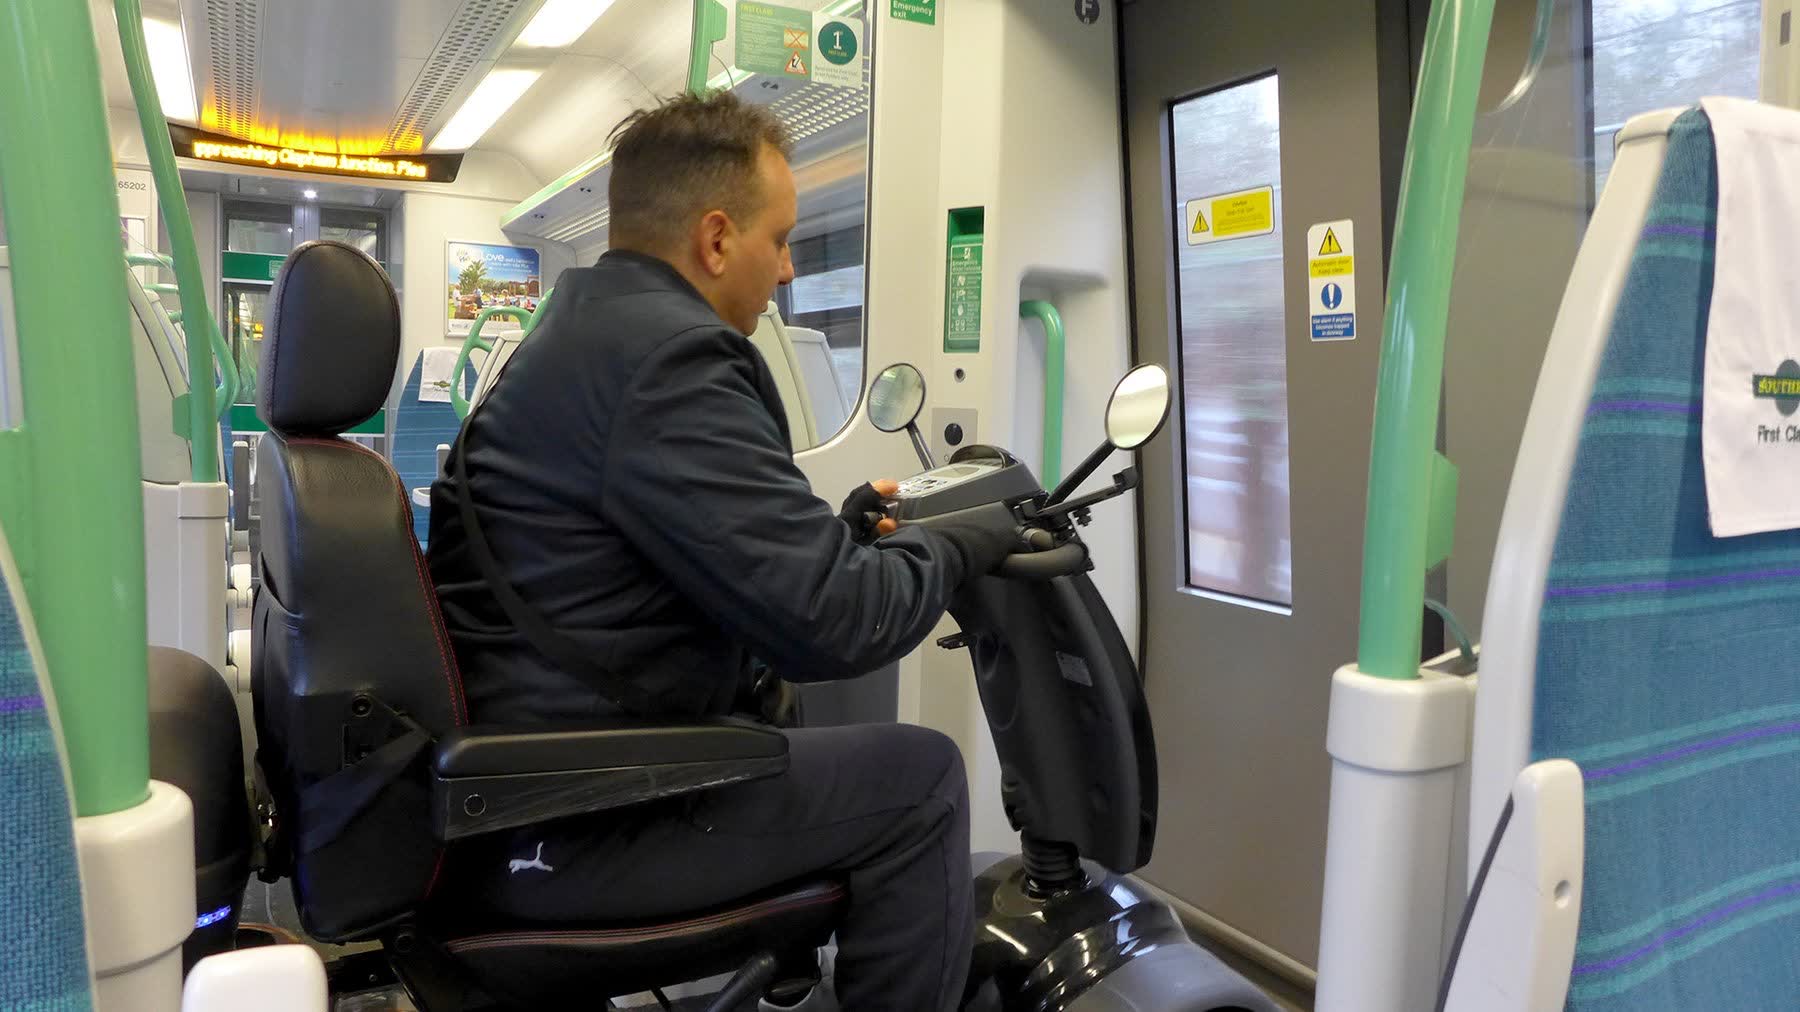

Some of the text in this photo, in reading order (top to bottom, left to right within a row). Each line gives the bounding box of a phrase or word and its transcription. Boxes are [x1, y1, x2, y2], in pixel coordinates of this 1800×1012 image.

[893, 2, 932, 16] Emergency
[893, 10, 907, 18] exit
[118, 180, 146, 191] 65202
[1757, 425, 1781, 444] First
